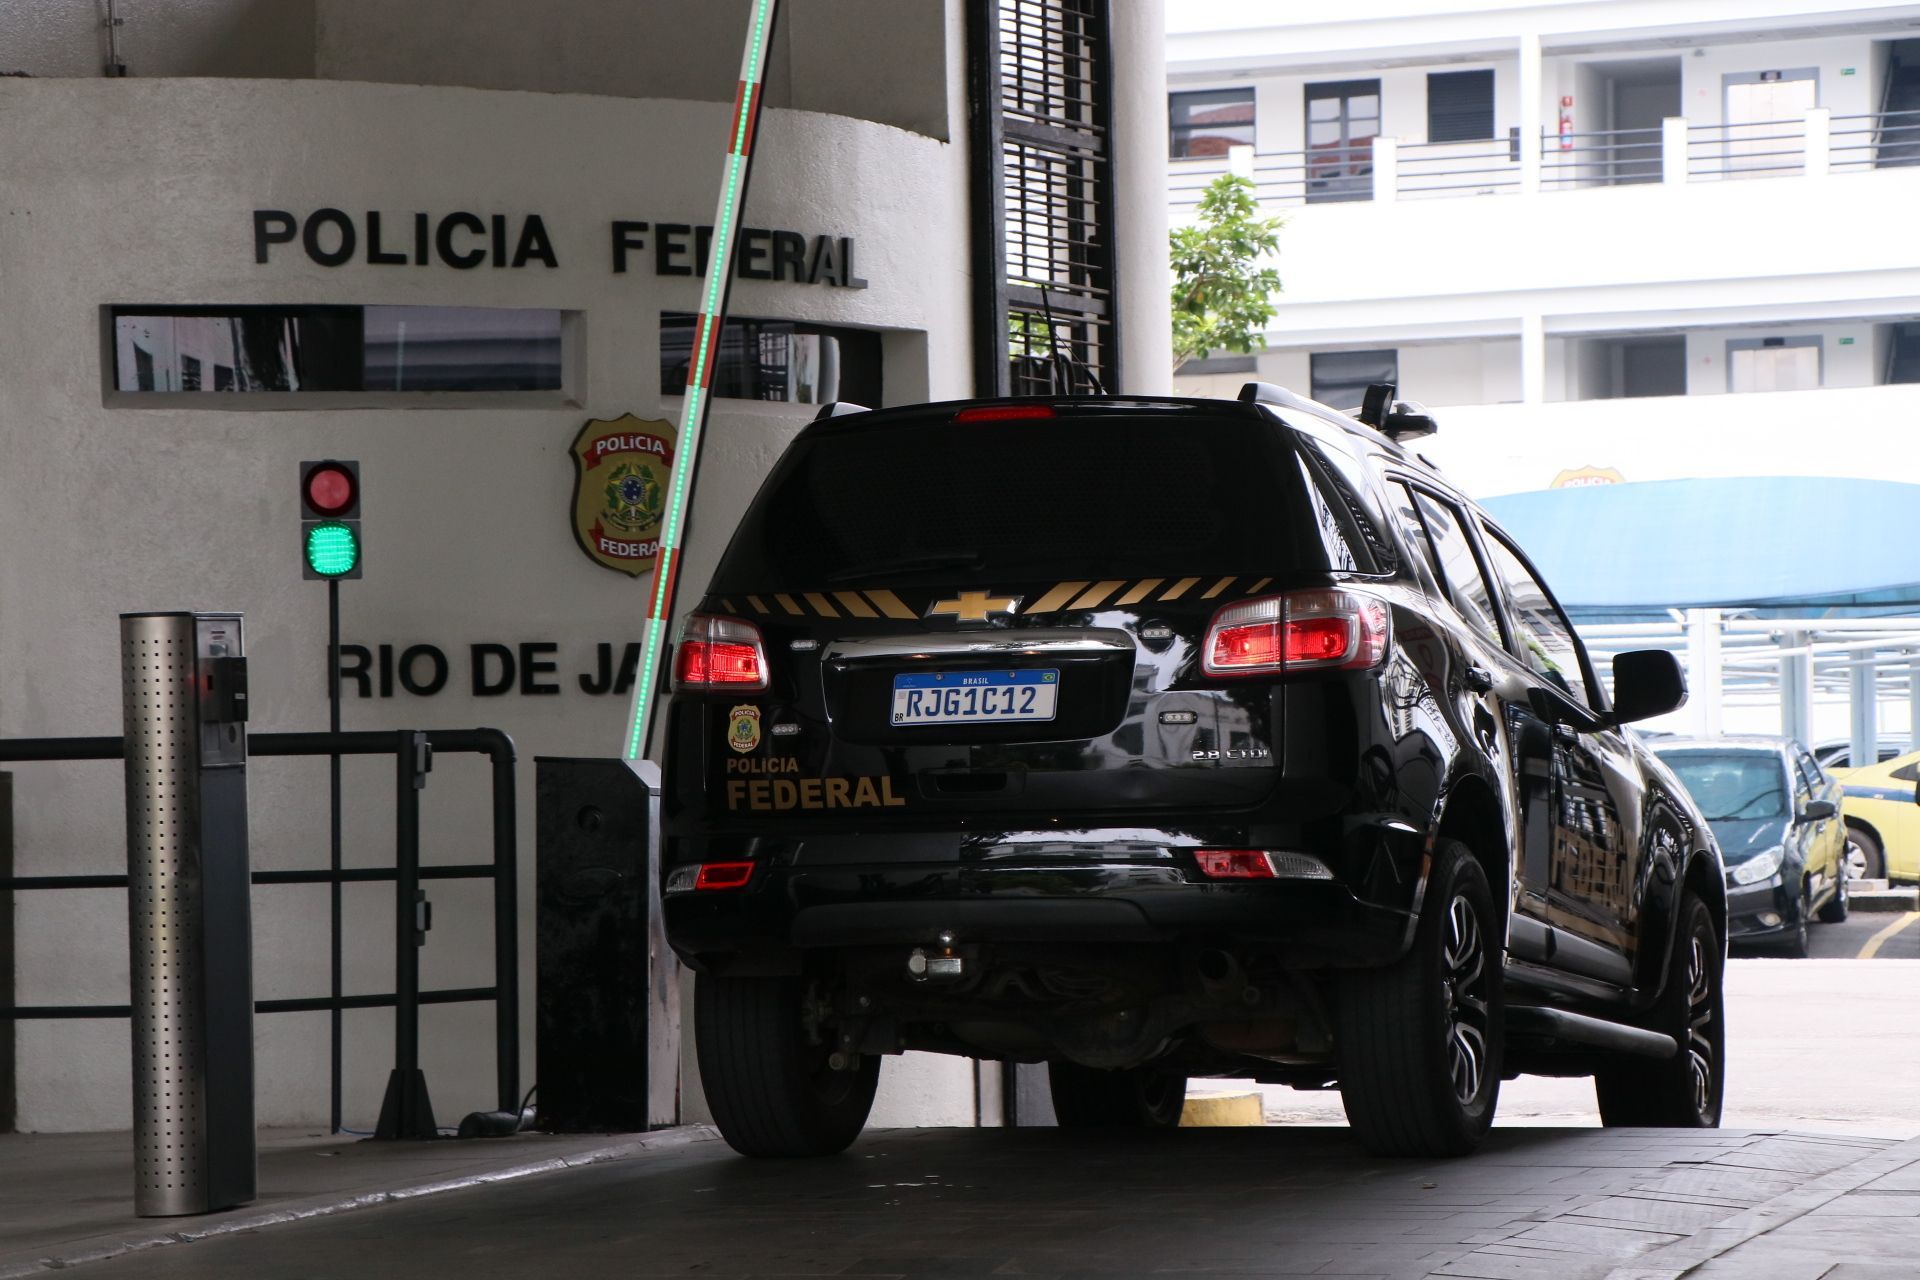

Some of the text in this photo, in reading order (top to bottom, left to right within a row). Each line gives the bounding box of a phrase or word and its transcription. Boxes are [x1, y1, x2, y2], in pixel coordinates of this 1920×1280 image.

[253, 208, 558, 269] POLICIA
[600, 537, 661, 557] FEDERA
[327, 643, 449, 698] RIO
[470, 642, 560, 697] DE
[962, 677, 989, 685] BRASIL
[894, 713, 904, 722] BR
[906, 686, 1037, 718] RJG1C12
[727, 775, 906, 811] FEDERAL
